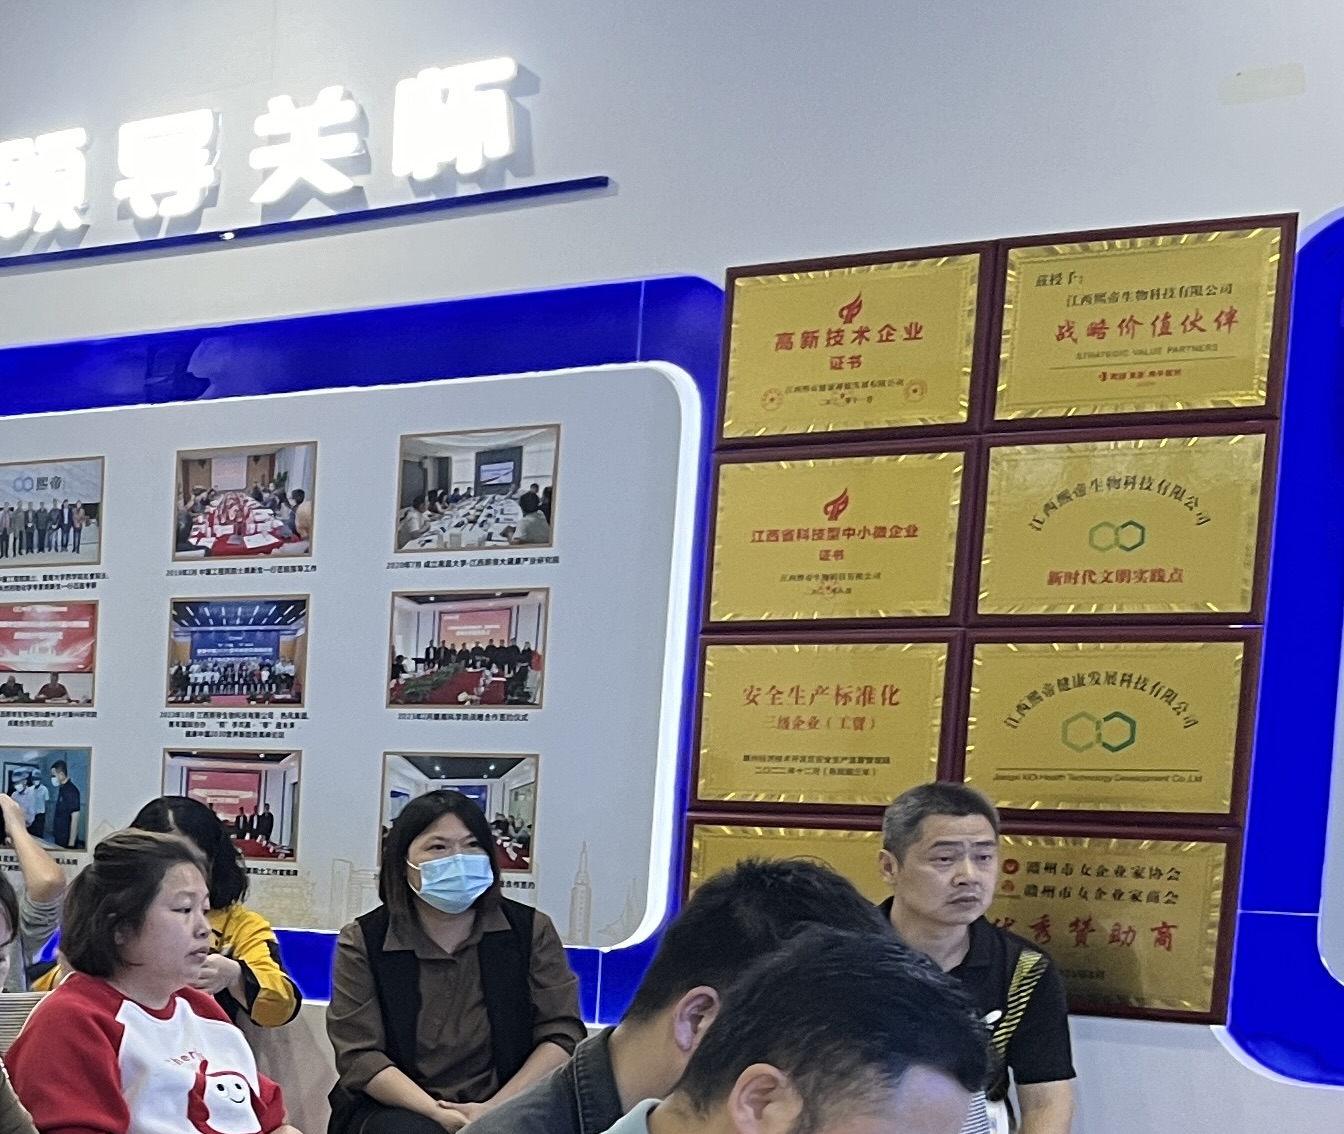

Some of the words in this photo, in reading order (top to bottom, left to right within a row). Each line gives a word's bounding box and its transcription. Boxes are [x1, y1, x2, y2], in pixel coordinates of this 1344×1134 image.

[1054, 305, 1239, 344] 战略价值伙伴
[774, 321, 924, 352] 高新技术企业
[829, 355, 863, 371] 证书
[750, 524, 919, 543] 江西省科技型中小微企业
[819, 549, 845, 561] 证书
[1047, 567, 1184, 586] 新时代文明实践点
[743, 684, 901, 707] 安全生产标准化
[1026, 860, 1182, 882] 赣州市女企业家协会
[1024, 883, 1180, 905] 赣州市女企业家商会
